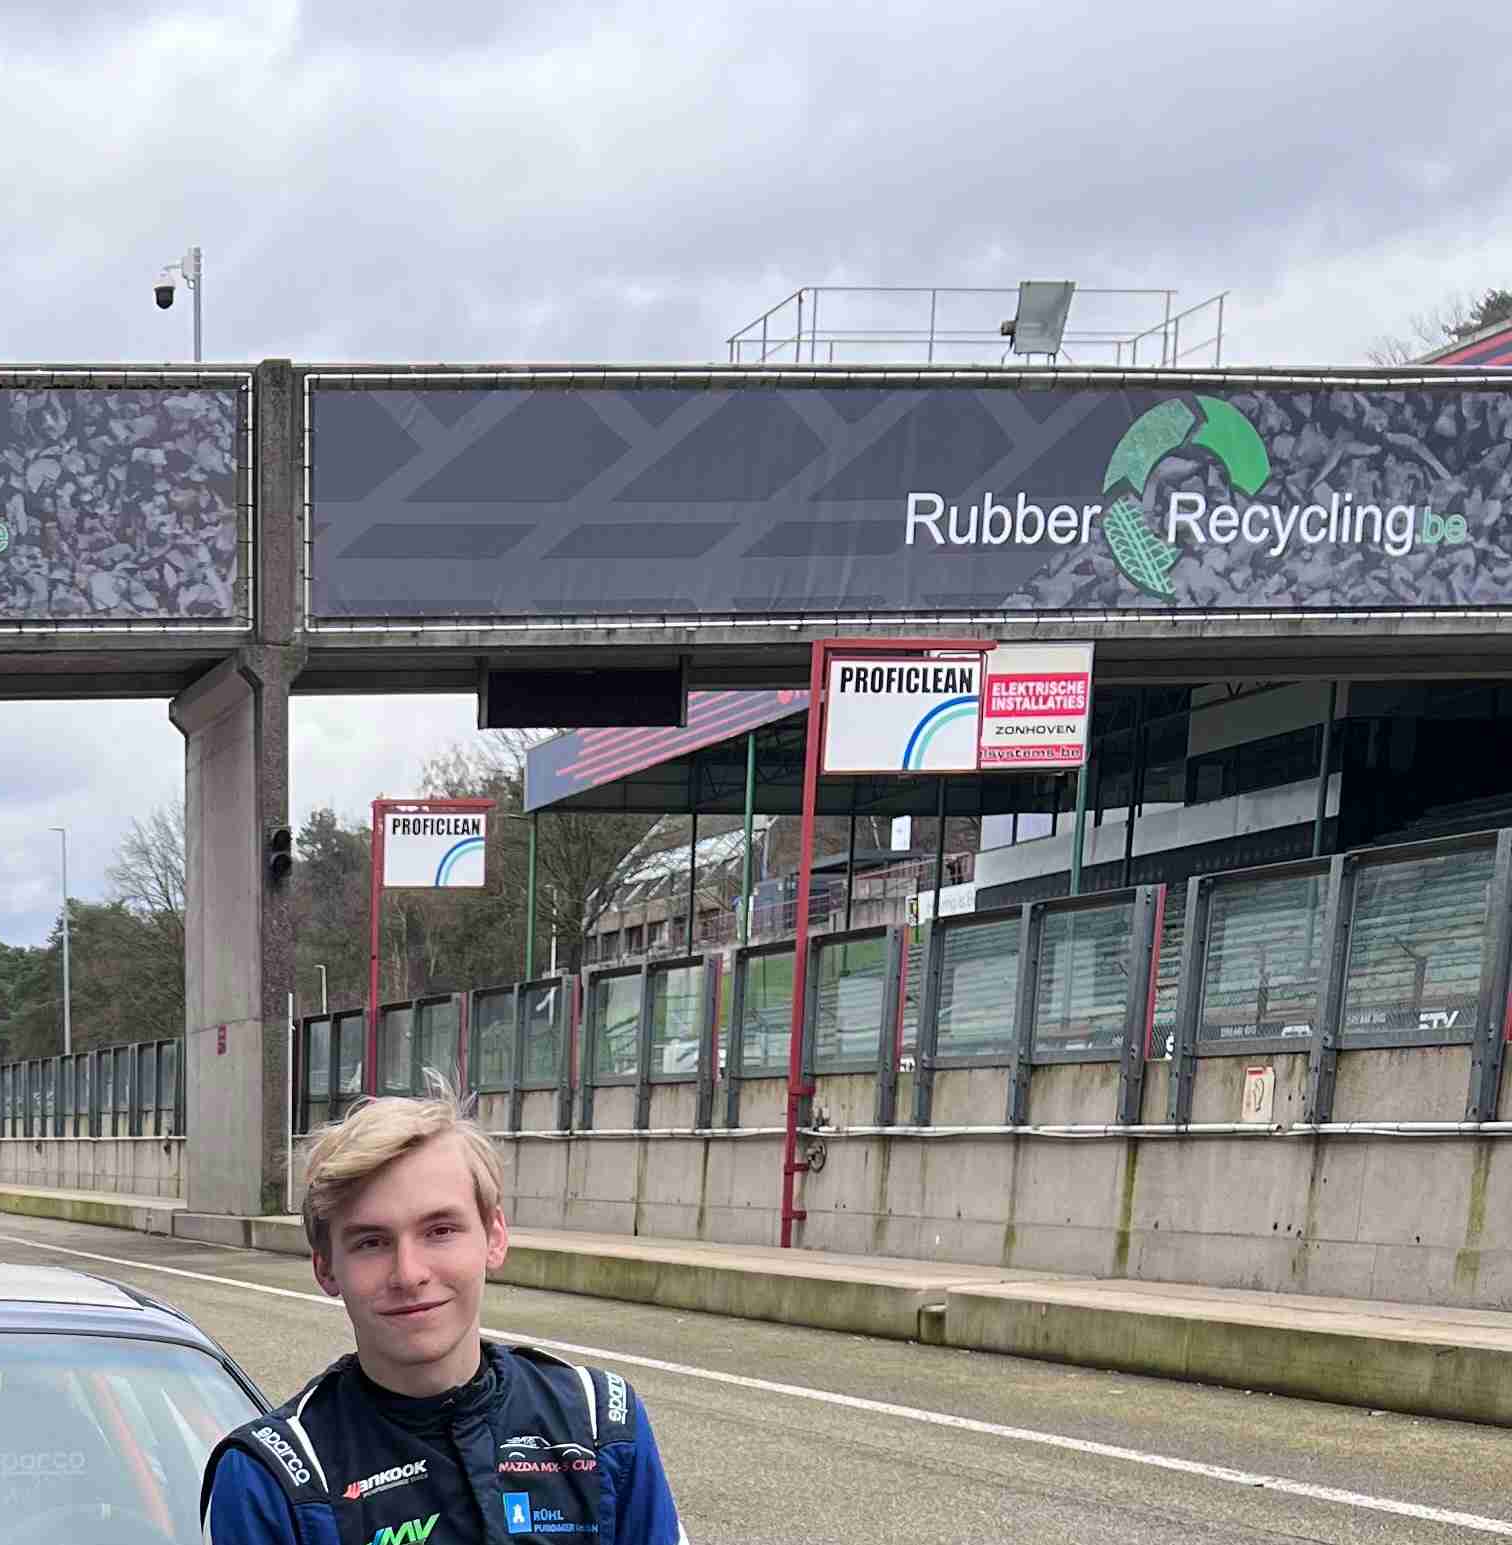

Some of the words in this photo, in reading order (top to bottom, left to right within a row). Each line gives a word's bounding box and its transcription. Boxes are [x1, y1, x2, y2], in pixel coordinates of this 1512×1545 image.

[904, 491, 1102, 545] Rubber
[1167, 491, 1468, 557] Recycling.be
[839, 666, 975, 695] PROFICLEAN
[992, 680, 1086, 696] ELEKTRISCHE
[991, 695, 1086, 712] INSTALLATIES
[995, 724, 1077, 736] ZONHOVEN
[391, 815, 482, 837] PROFICLEAN
[252, 1427, 311, 1486] sparco
[571, 1458, 597, 1472] CUP
